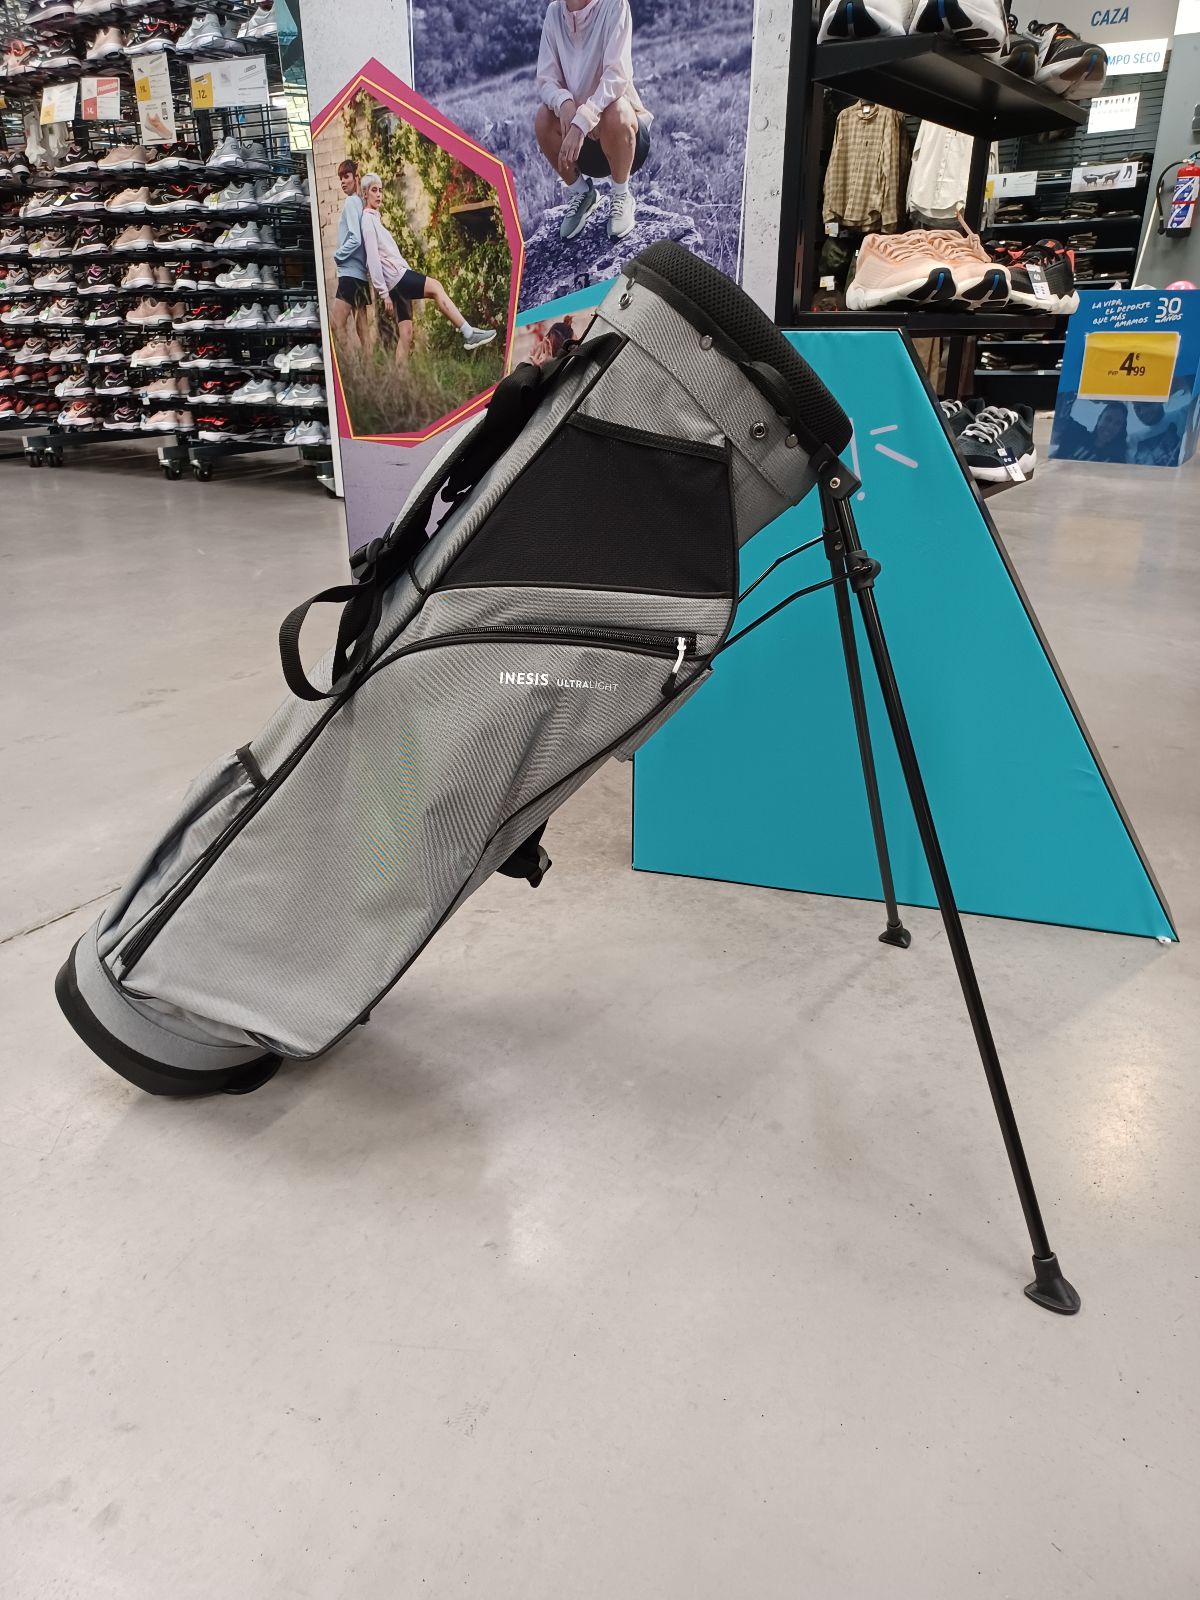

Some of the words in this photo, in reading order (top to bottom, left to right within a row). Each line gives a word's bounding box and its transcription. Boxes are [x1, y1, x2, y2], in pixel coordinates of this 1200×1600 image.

[1091, 7, 1129, 26] CAZA
[1106, 54, 1130, 66] MPO
[1132, 52, 1161, 64] SECO
[1117, 301, 1151, 312] DEPORTE
[1155, 297, 1181, 320] 30
[1092, 317, 1108, 325] QUE
[1114, 316, 1149, 328] AMAMOS
[499, 671, 549, 686] INESIS
[556, 678, 619, 692] ULTRALIGHT
